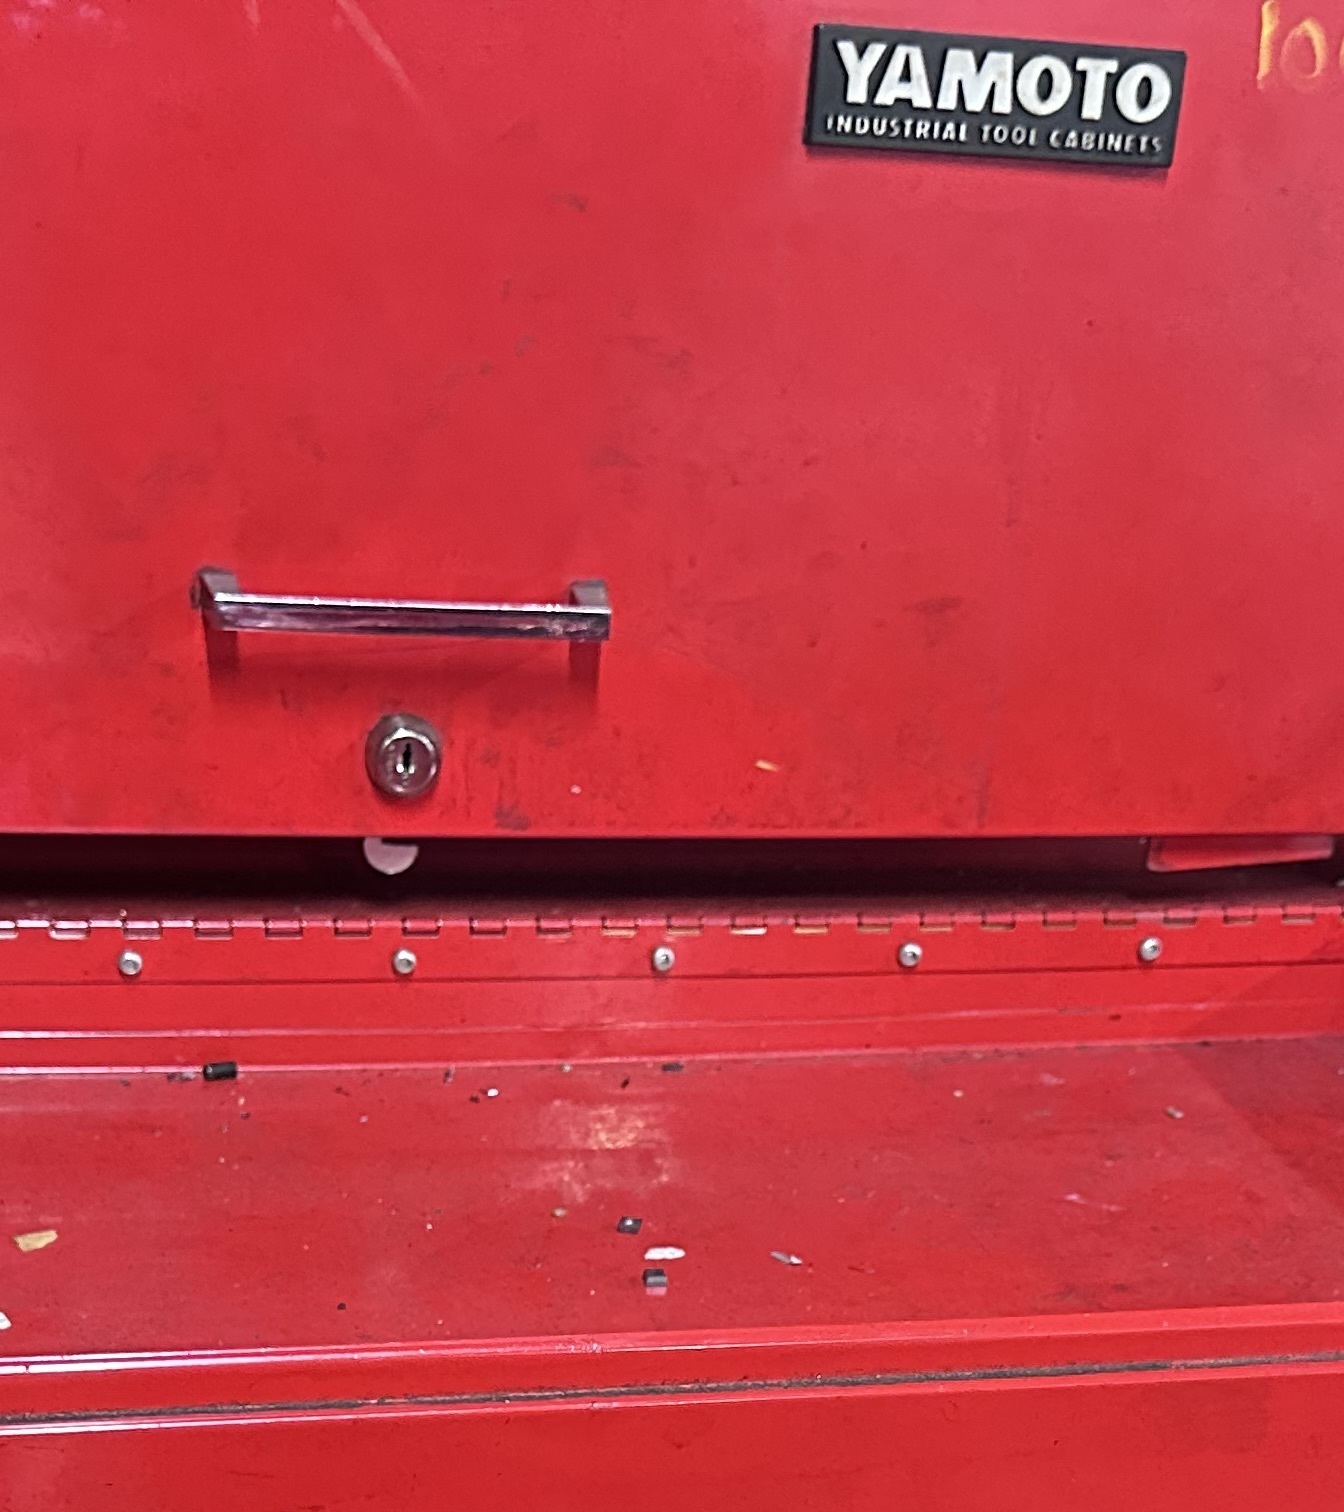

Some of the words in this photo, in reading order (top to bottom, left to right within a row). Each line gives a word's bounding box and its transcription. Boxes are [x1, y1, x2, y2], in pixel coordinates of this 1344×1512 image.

[835, 39, 1173, 124] YAMOTO
[825, 113, 968, 143] INDUSTRIAL
[979, 123, 1039, 147] TOOL
[1049, 129, 1163, 154] CABINETS
